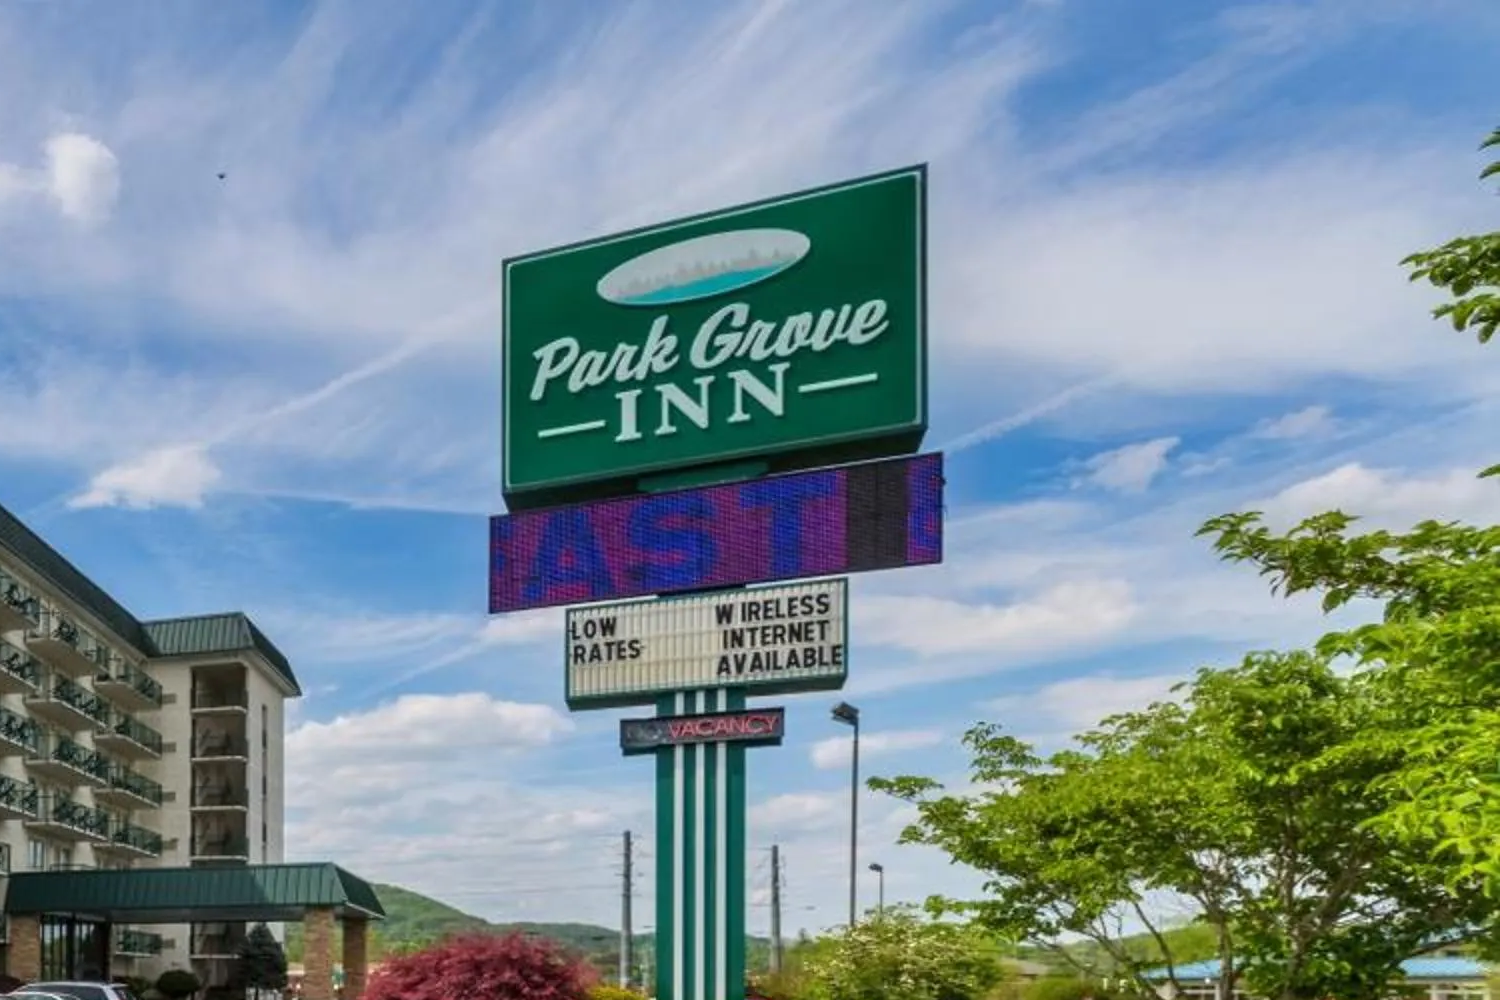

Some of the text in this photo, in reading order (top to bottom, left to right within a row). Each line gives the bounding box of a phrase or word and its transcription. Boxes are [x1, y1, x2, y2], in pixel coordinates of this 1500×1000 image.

[529, 298, 890, 401] Park Grove
[614, 362, 792, 443] INN
[715, 593, 831, 625] WIRELESS
[571, 616, 618, 641] LOW
[722, 619, 830, 650] INTERNET
[572, 638, 642, 666] RATES
[715, 643, 843, 677] AVAILABLE
[668, 714, 778, 739] VACANCY
